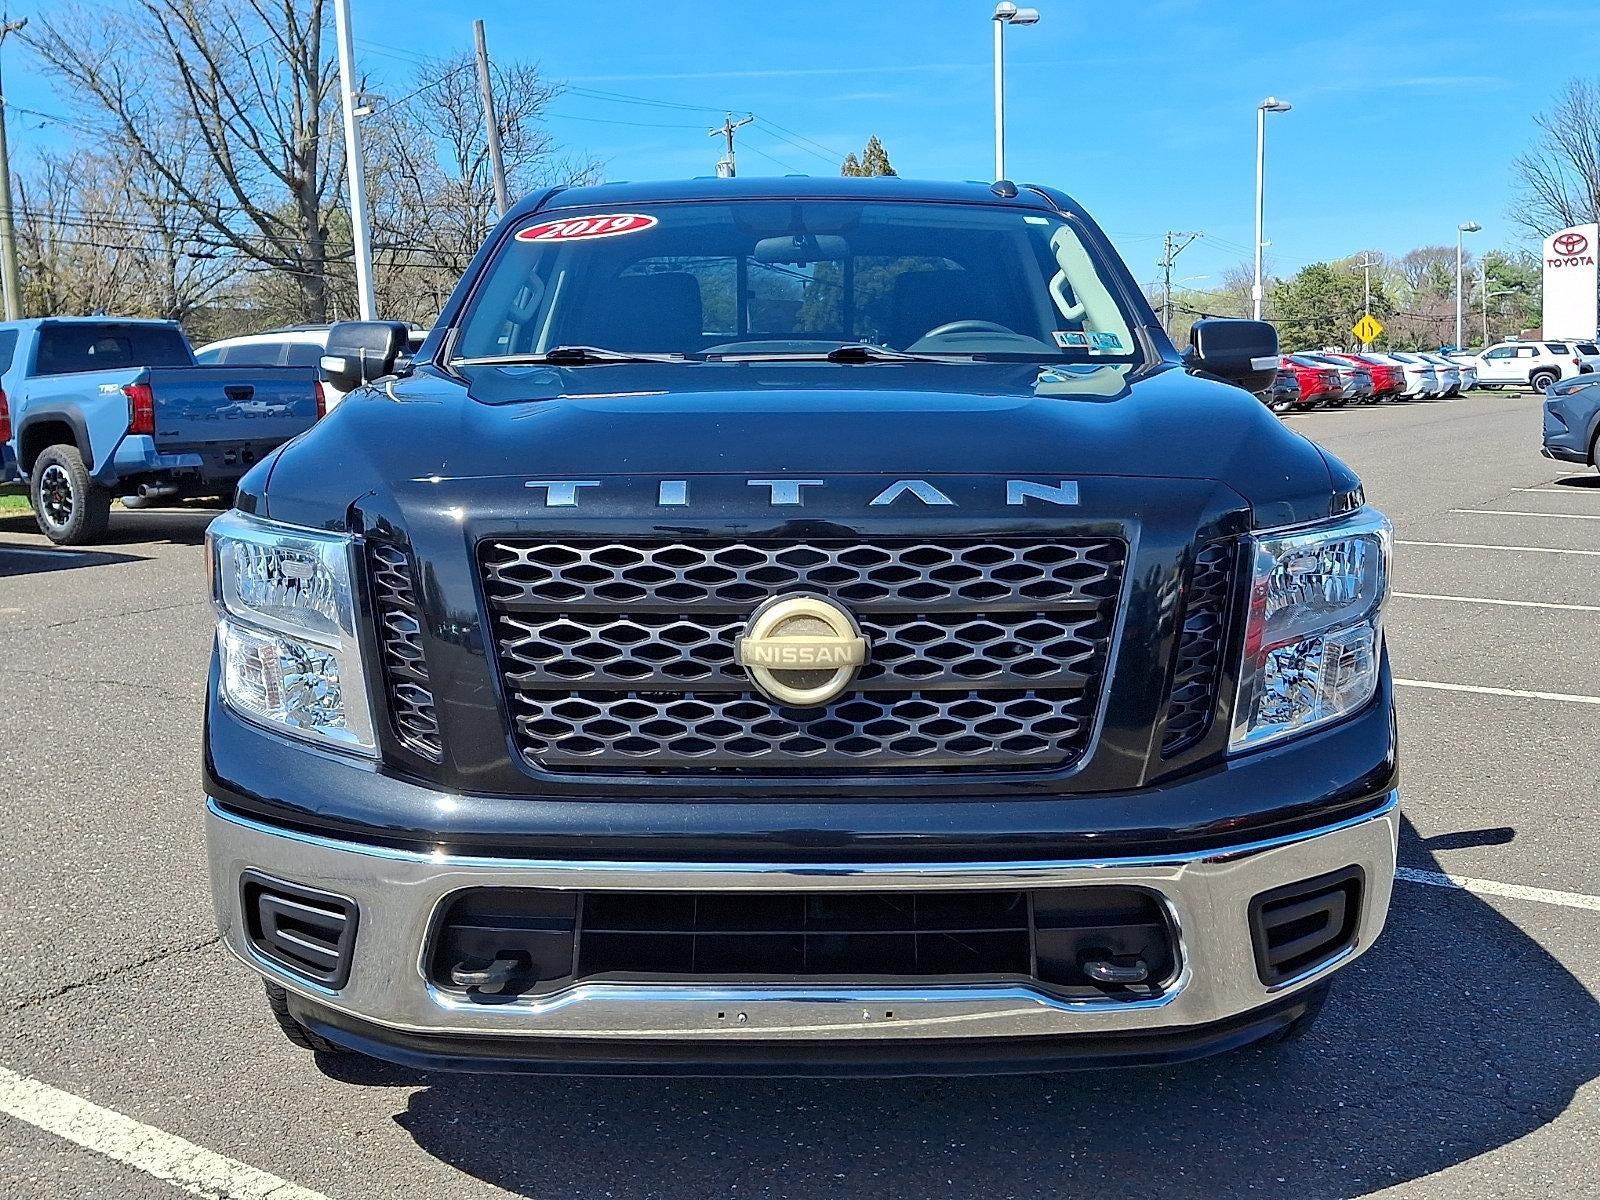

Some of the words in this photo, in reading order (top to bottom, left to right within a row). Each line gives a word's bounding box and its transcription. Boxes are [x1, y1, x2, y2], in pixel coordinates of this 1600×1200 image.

[535, 215, 635, 239] 2019
[1547, 256, 1594, 268] TOYOTA
[98, 383, 119, 393] TRD
[524, 479, 1080, 507] TITAN
[754, 646, 852, 663] NISSAN
